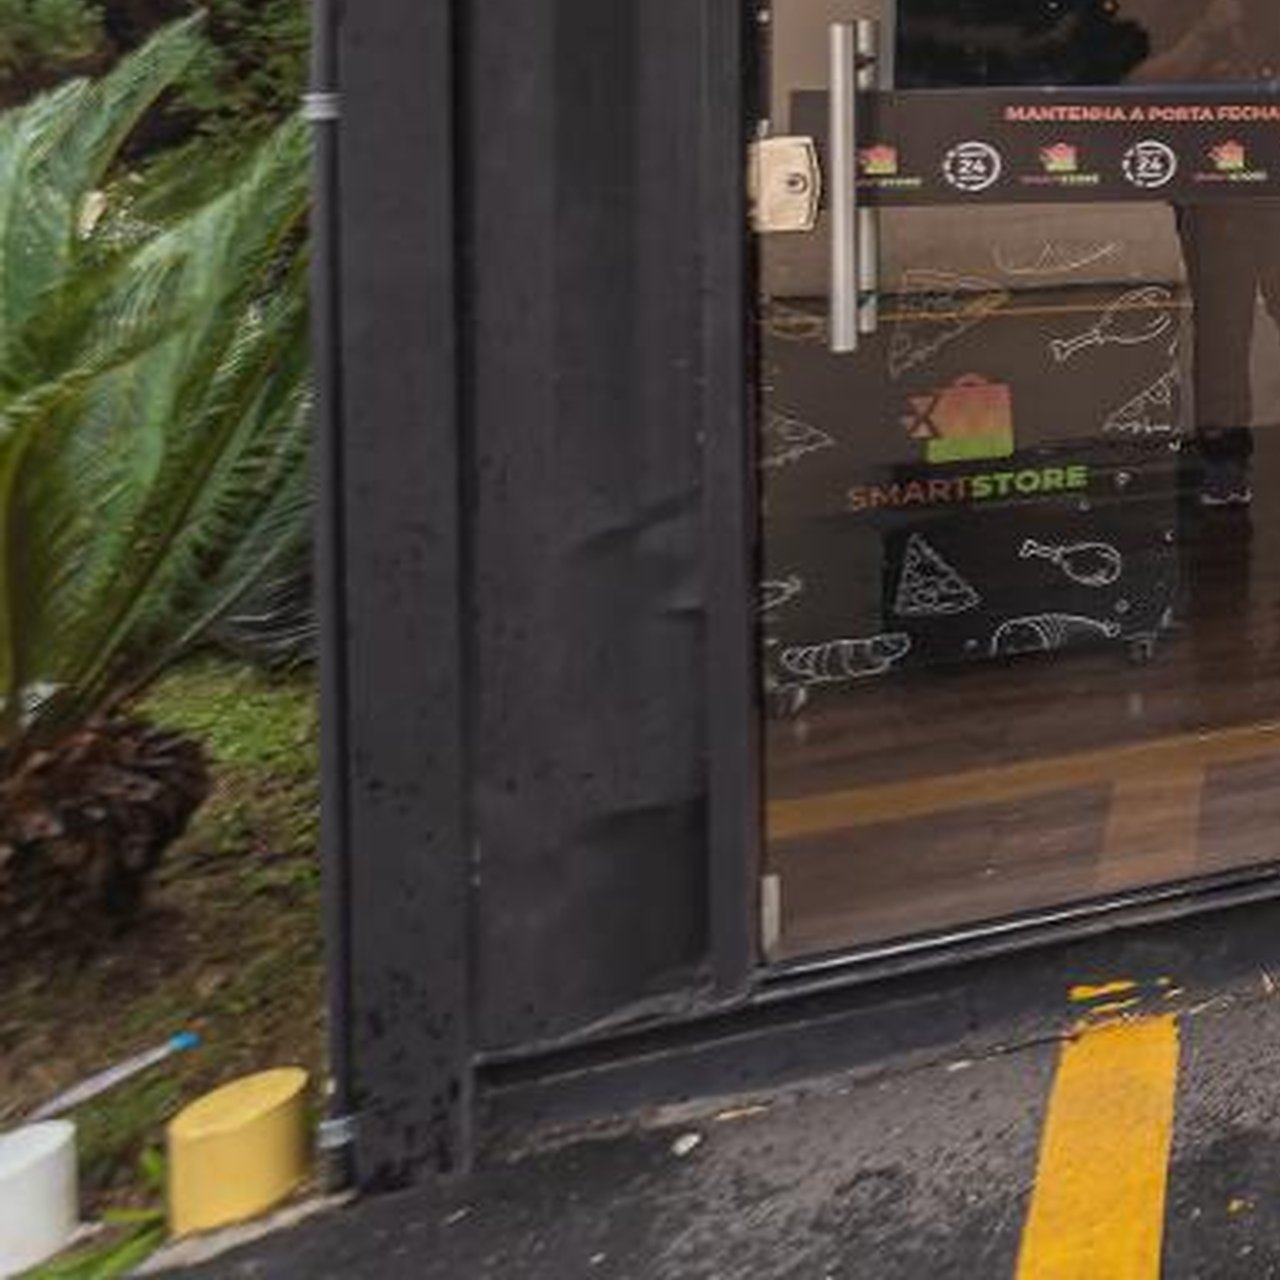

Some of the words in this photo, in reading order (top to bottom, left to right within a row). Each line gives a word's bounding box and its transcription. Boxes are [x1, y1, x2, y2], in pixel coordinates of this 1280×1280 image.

[1007, 105, 1126, 121] MANTENHA
[1129, 105, 1146, 121] A
[1149, 105, 1214, 121] PORTA
[848, 465, 1087, 511] SMARTSTORE
